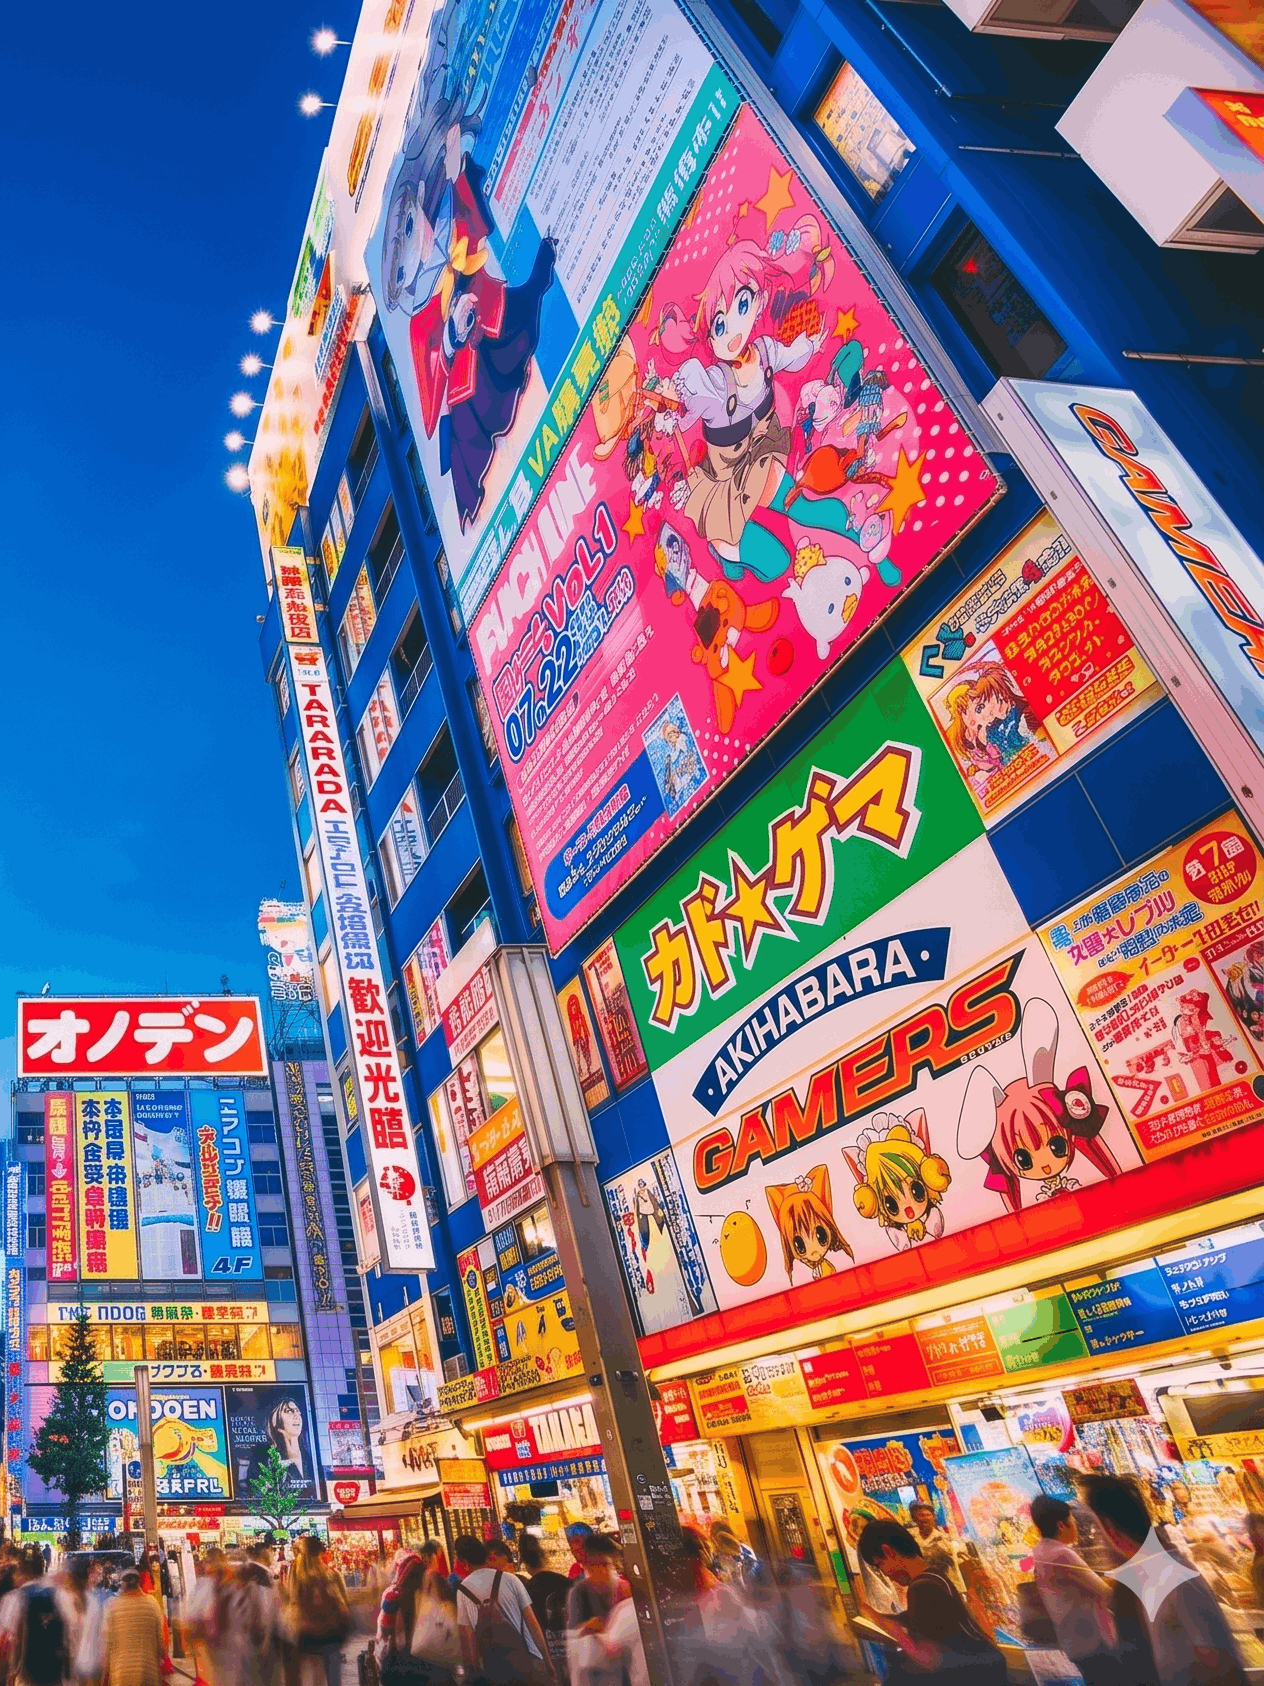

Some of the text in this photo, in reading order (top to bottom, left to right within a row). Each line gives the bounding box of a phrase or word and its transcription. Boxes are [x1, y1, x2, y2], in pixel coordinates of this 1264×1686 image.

[301, 683, 348, 813] TARARADA
[27, 1000, 254, 1065] オノデン
[693, 948, 1027, 1194] GAMERS
[714, 938, 917, 1097] AKIHABARA
[211, 1256, 253, 1274] 4F
